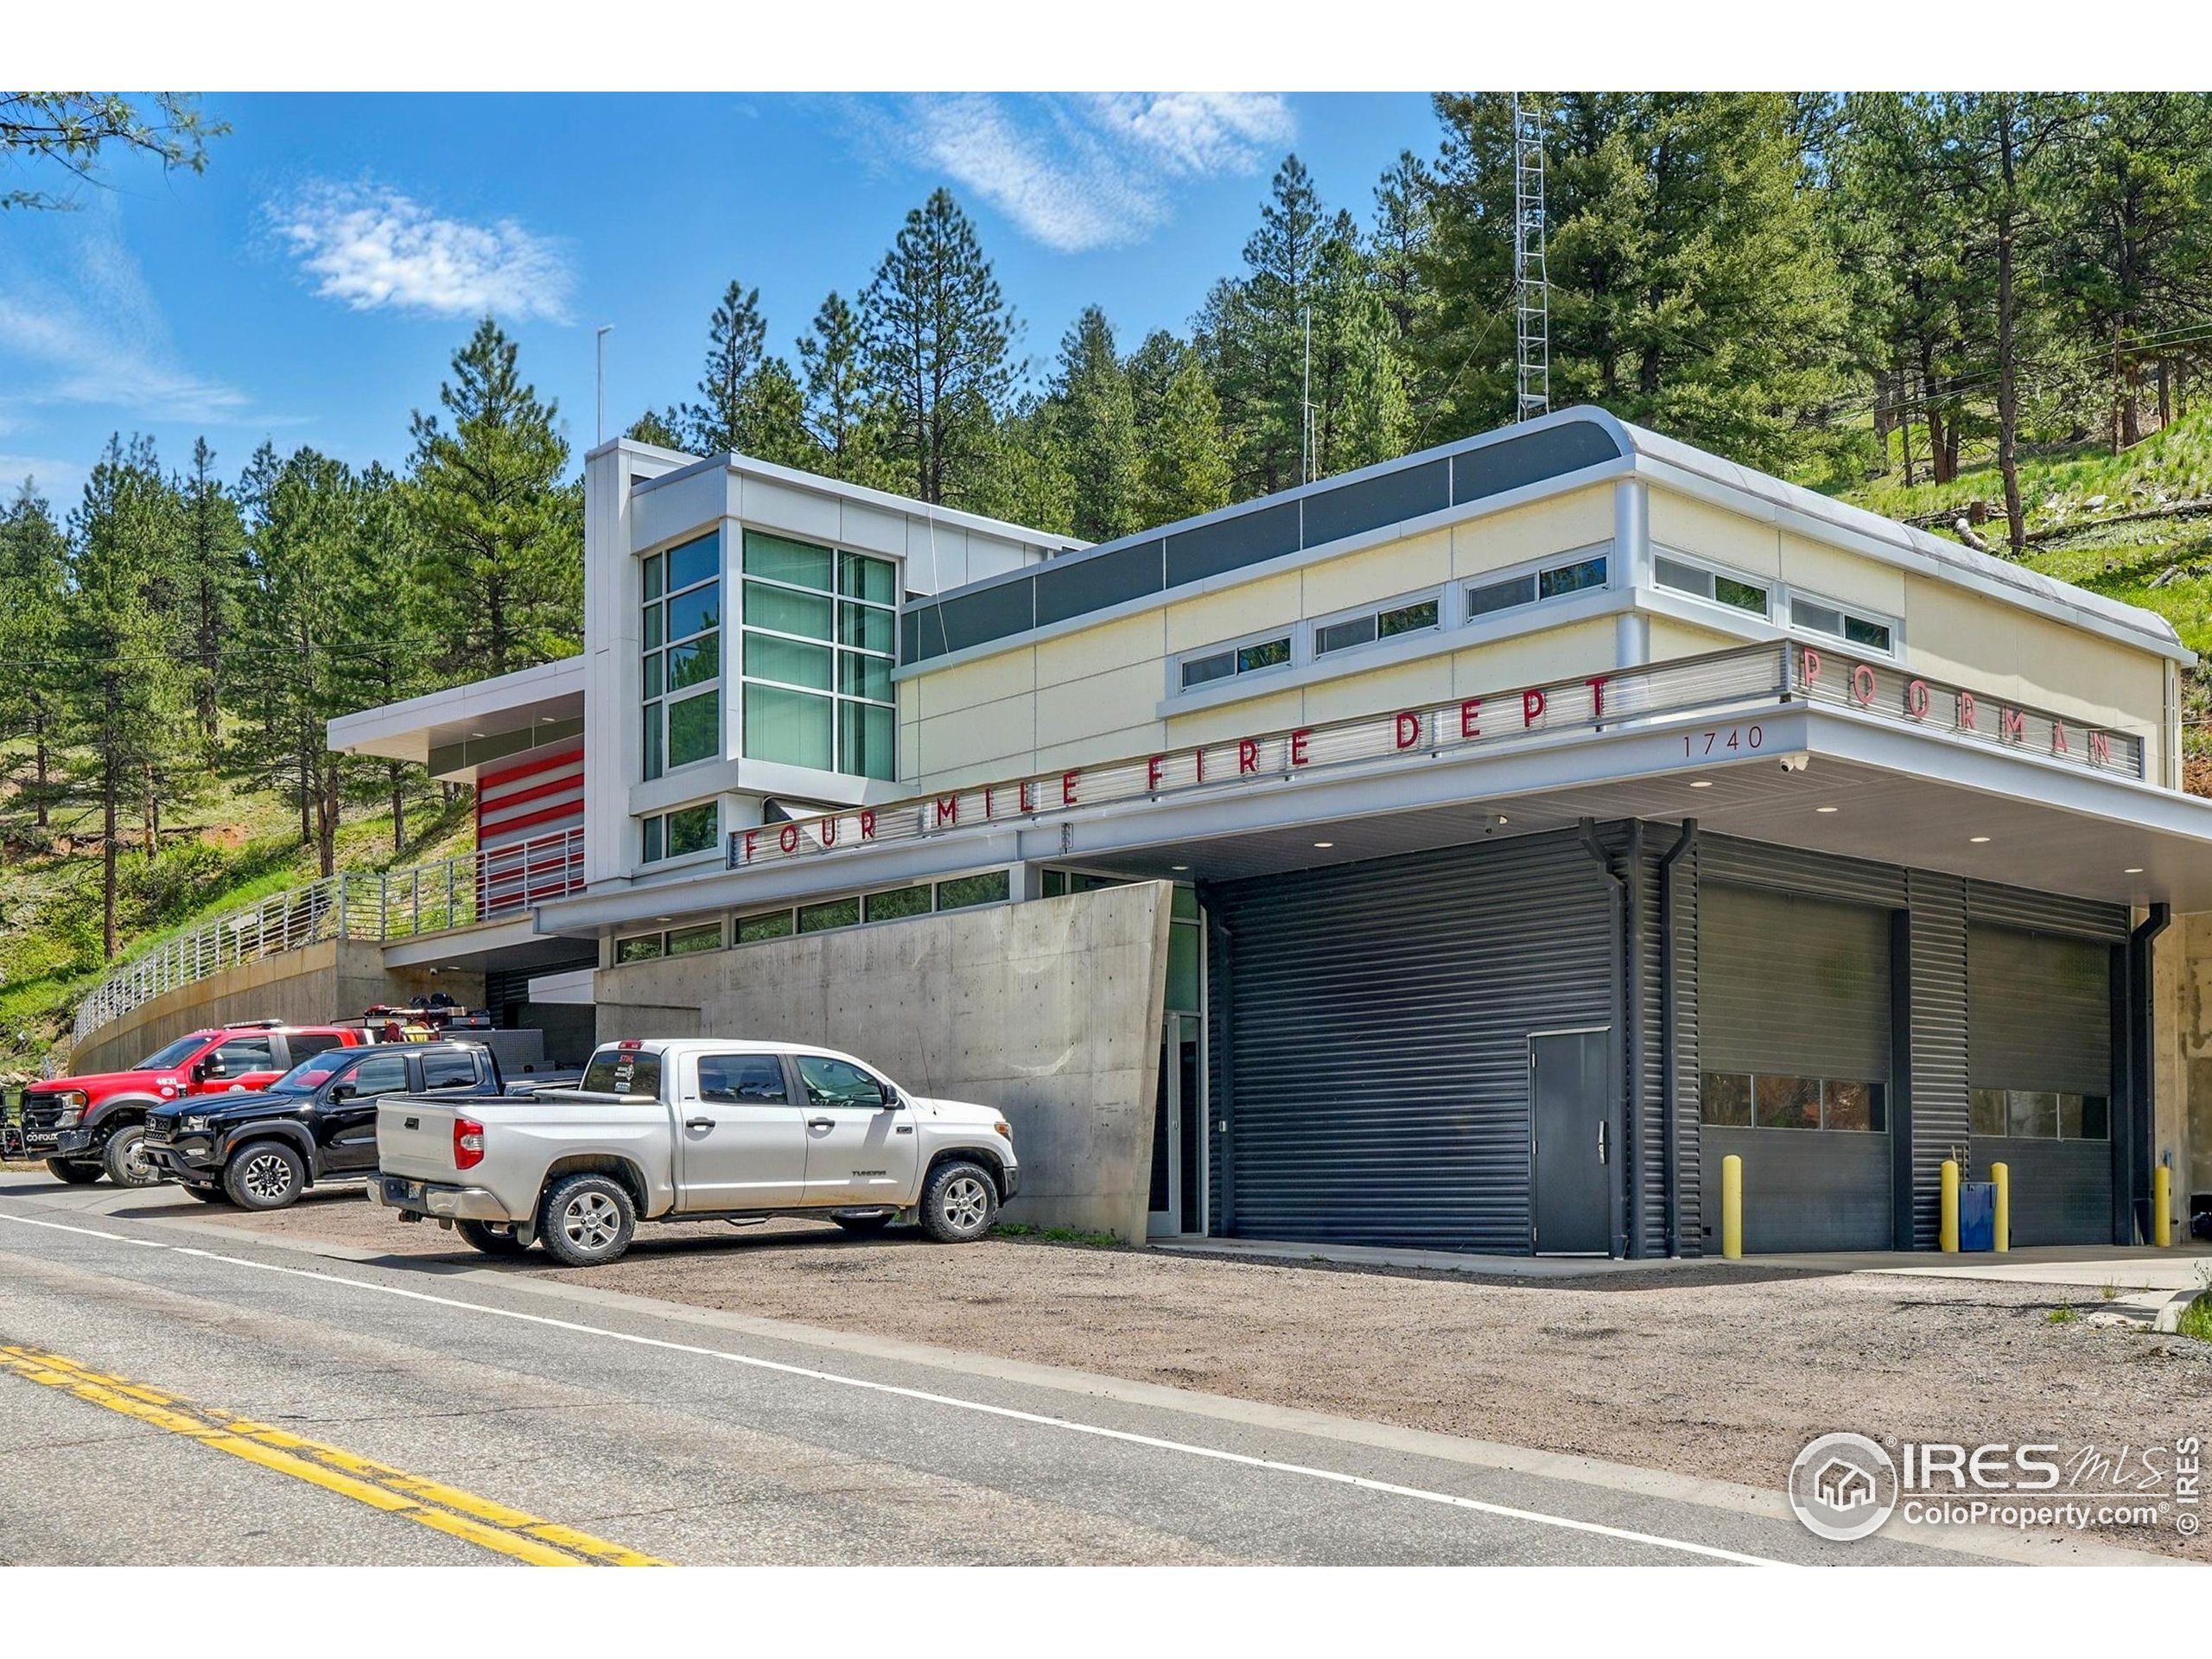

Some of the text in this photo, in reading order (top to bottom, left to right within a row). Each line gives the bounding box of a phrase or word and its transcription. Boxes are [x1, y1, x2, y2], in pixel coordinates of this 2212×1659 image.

[1683, 725, 1764, 758] 1740
[1802, 647, 2110, 764] POORMAN
[745, 677, 1611, 859] FOUR MILE FIRE DEPT
